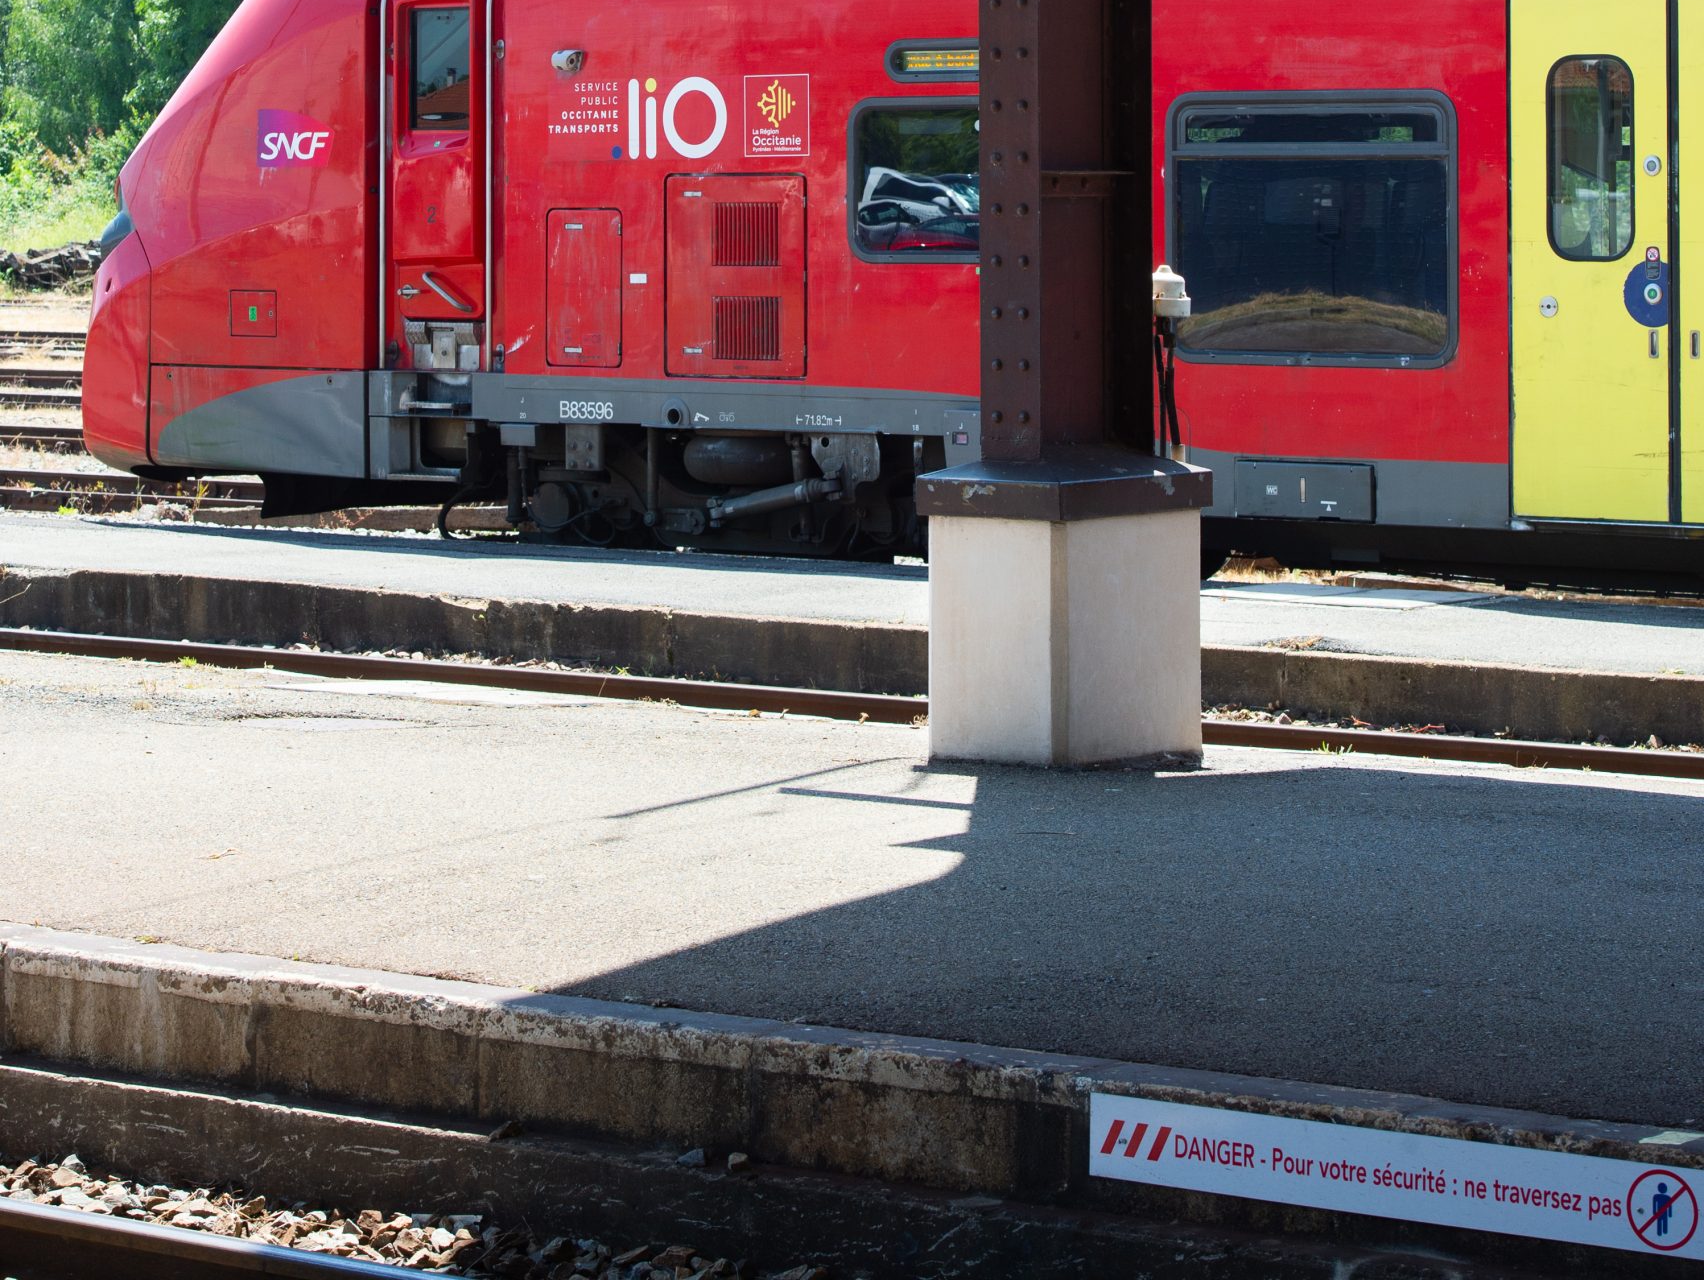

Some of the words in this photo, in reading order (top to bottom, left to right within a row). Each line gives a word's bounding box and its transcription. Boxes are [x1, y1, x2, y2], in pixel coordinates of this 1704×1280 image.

[574, 82, 618, 92] SERVICE
[580, 96, 618, 106] PUBLIC
[561, 110, 619, 120] OCCITANIE
[548, 124, 619, 134] TRANSPORTS
[759, 128, 779, 136] Région
[752, 134, 801, 146] Occitanie
[260, 131, 330, 160] SNCF
[427, 206, 436, 223] 2
[559, 400, 614, 419] B83596
[1266, 486, 1278, 495] WC
[1174, 1134, 1255, 1169] DANGER
[1272, 1148, 1314, 1176] Pour
[1319, 1160, 1367, 1183] votre
[1372, 1162, 1446, 1194] sécurité
[1452, 1179, 1457, 1195] :
[1464, 1179, 1487, 1199] ne
[1493, 1179, 1582, 1212] traversez
[1588, 1195, 1622, 1221] pas
